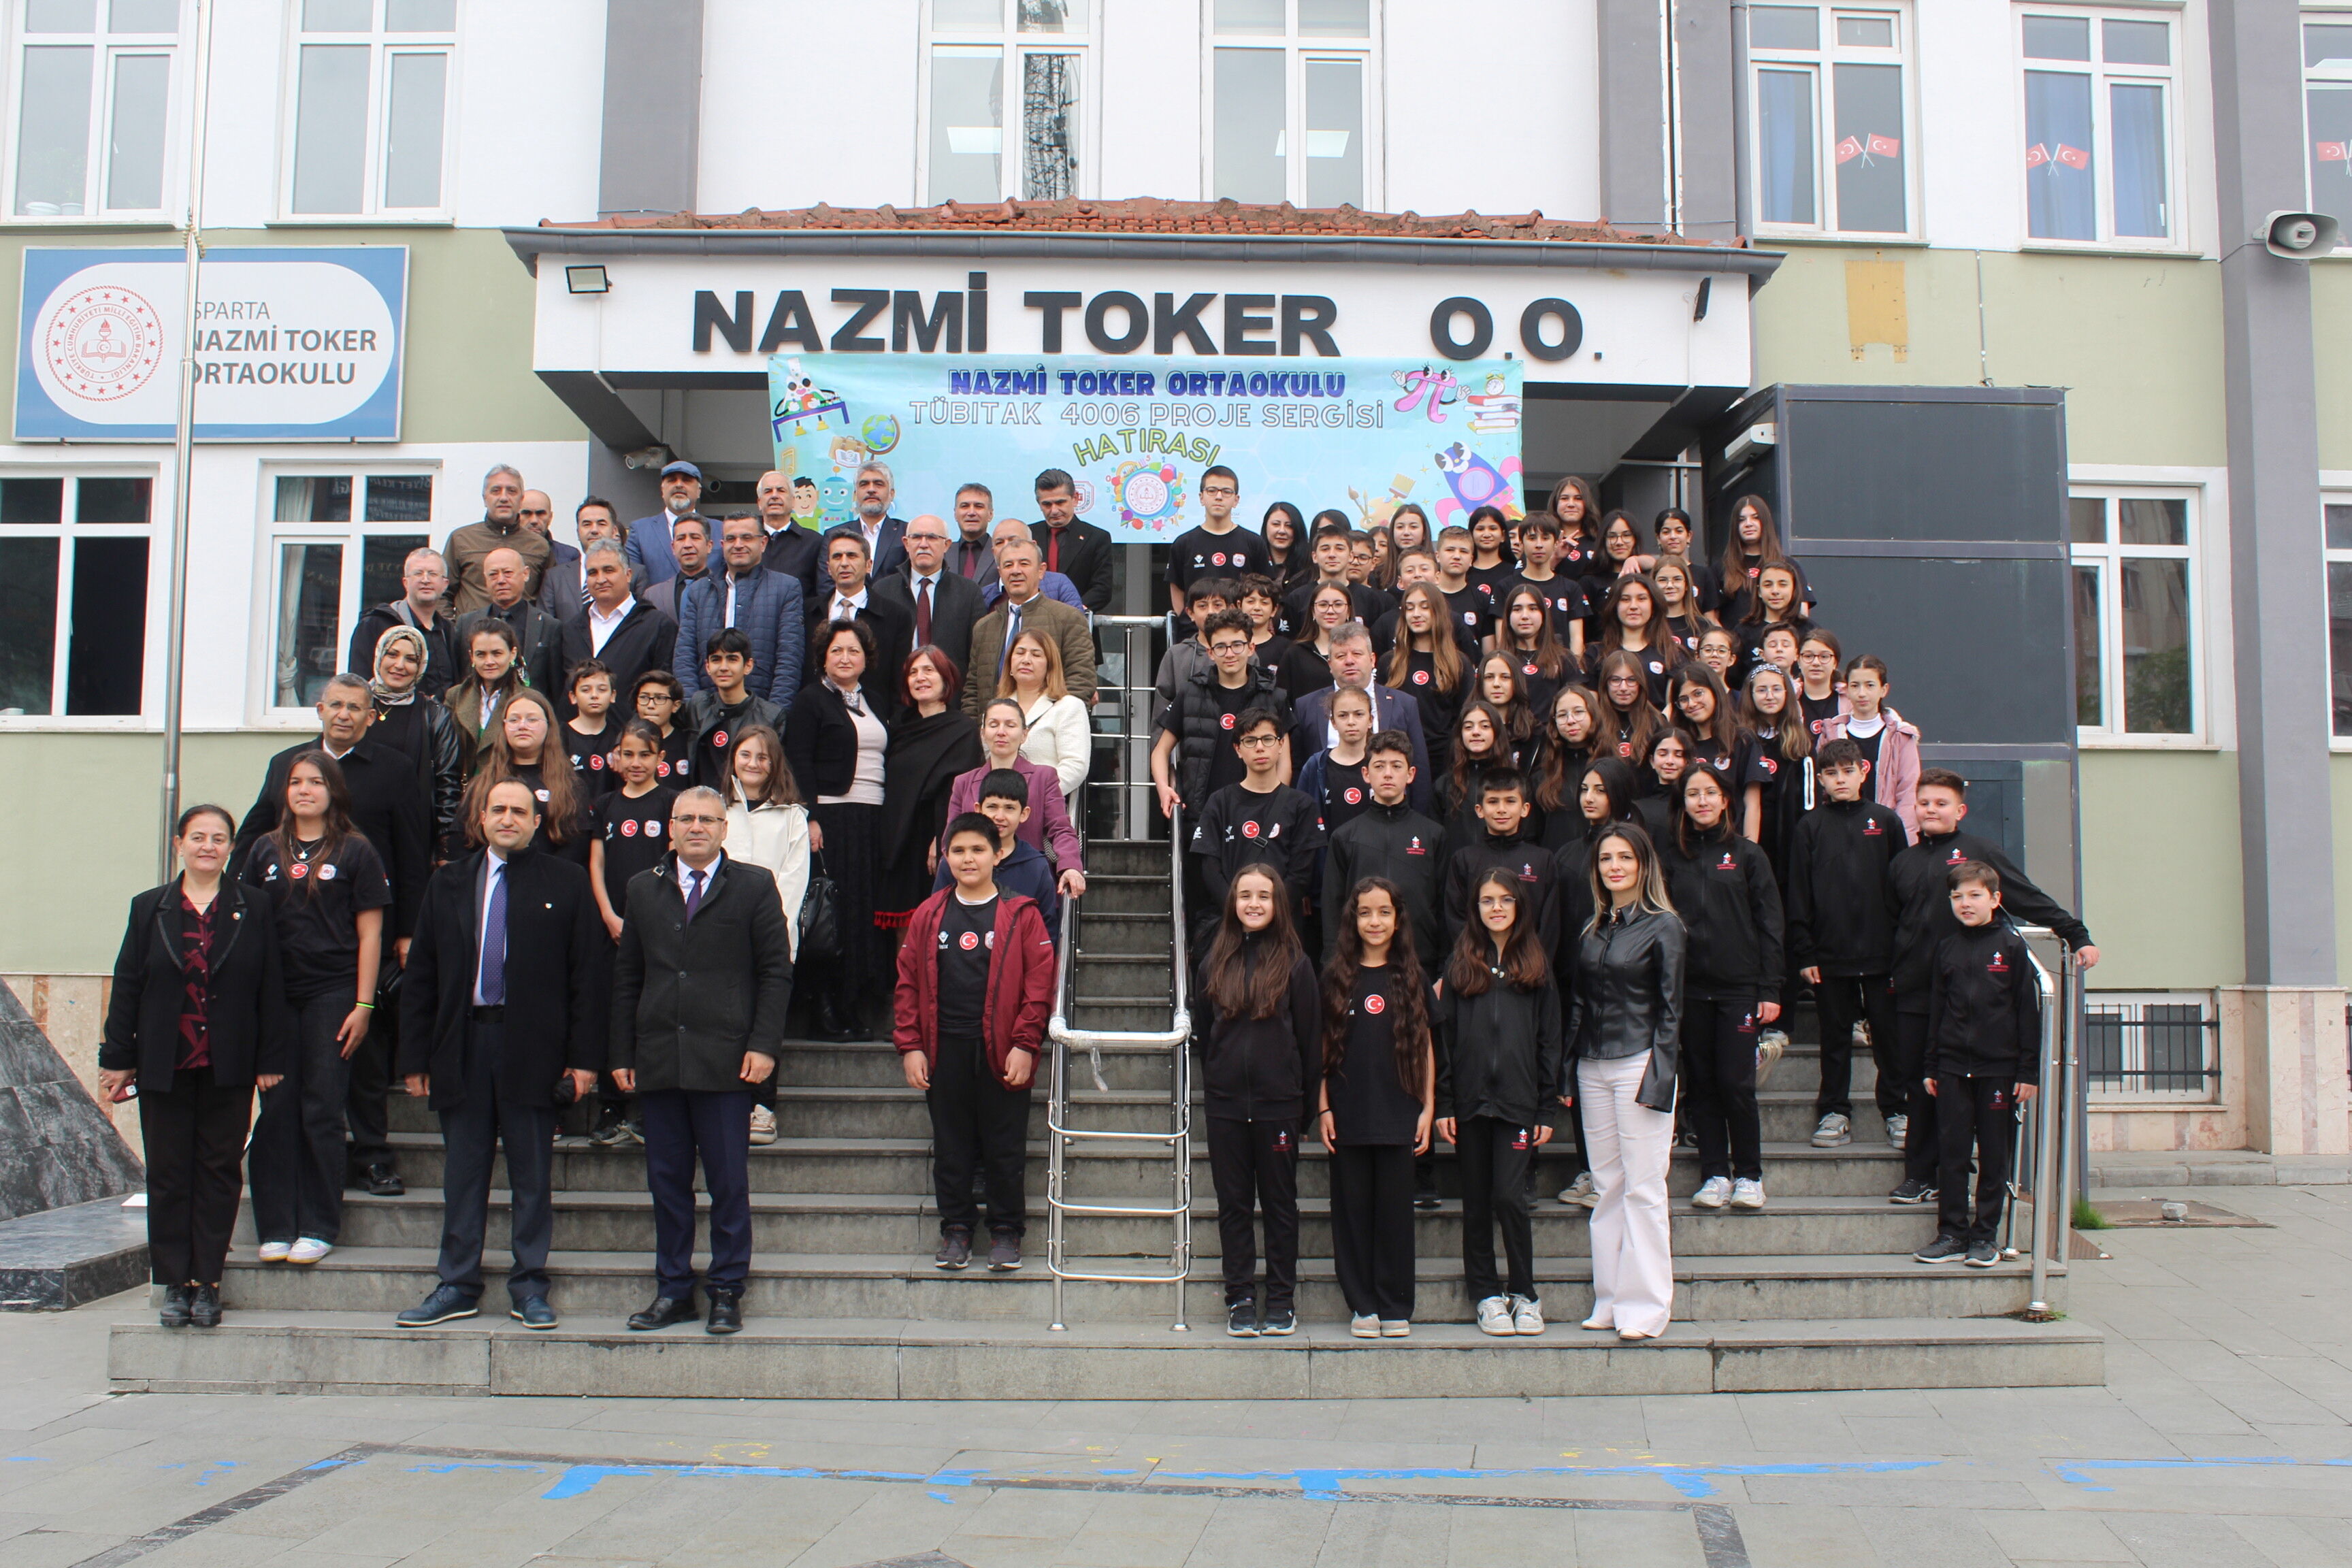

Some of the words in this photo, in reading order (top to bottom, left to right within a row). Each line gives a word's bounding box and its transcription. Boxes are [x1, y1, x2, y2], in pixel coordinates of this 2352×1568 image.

[195, 301, 270, 320] SPARTA
[693, 272, 987, 353] NAZMİ
[1024, 291, 1341, 357] TOKER
[284, 329, 376, 352] TOKER
[949, 363, 1047, 395] NAZMİ
[1058, 370, 1155, 396] TOKER
[1165, 370, 1345, 398] ORTAOKULU
[1060, 402, 1141, 425] 4006
[1150, 403, 1251, 427] PROJE
[1262, 399, 1384, 429] SERGİSİ
[1073, 428, 1221, 468] HATIRASI
